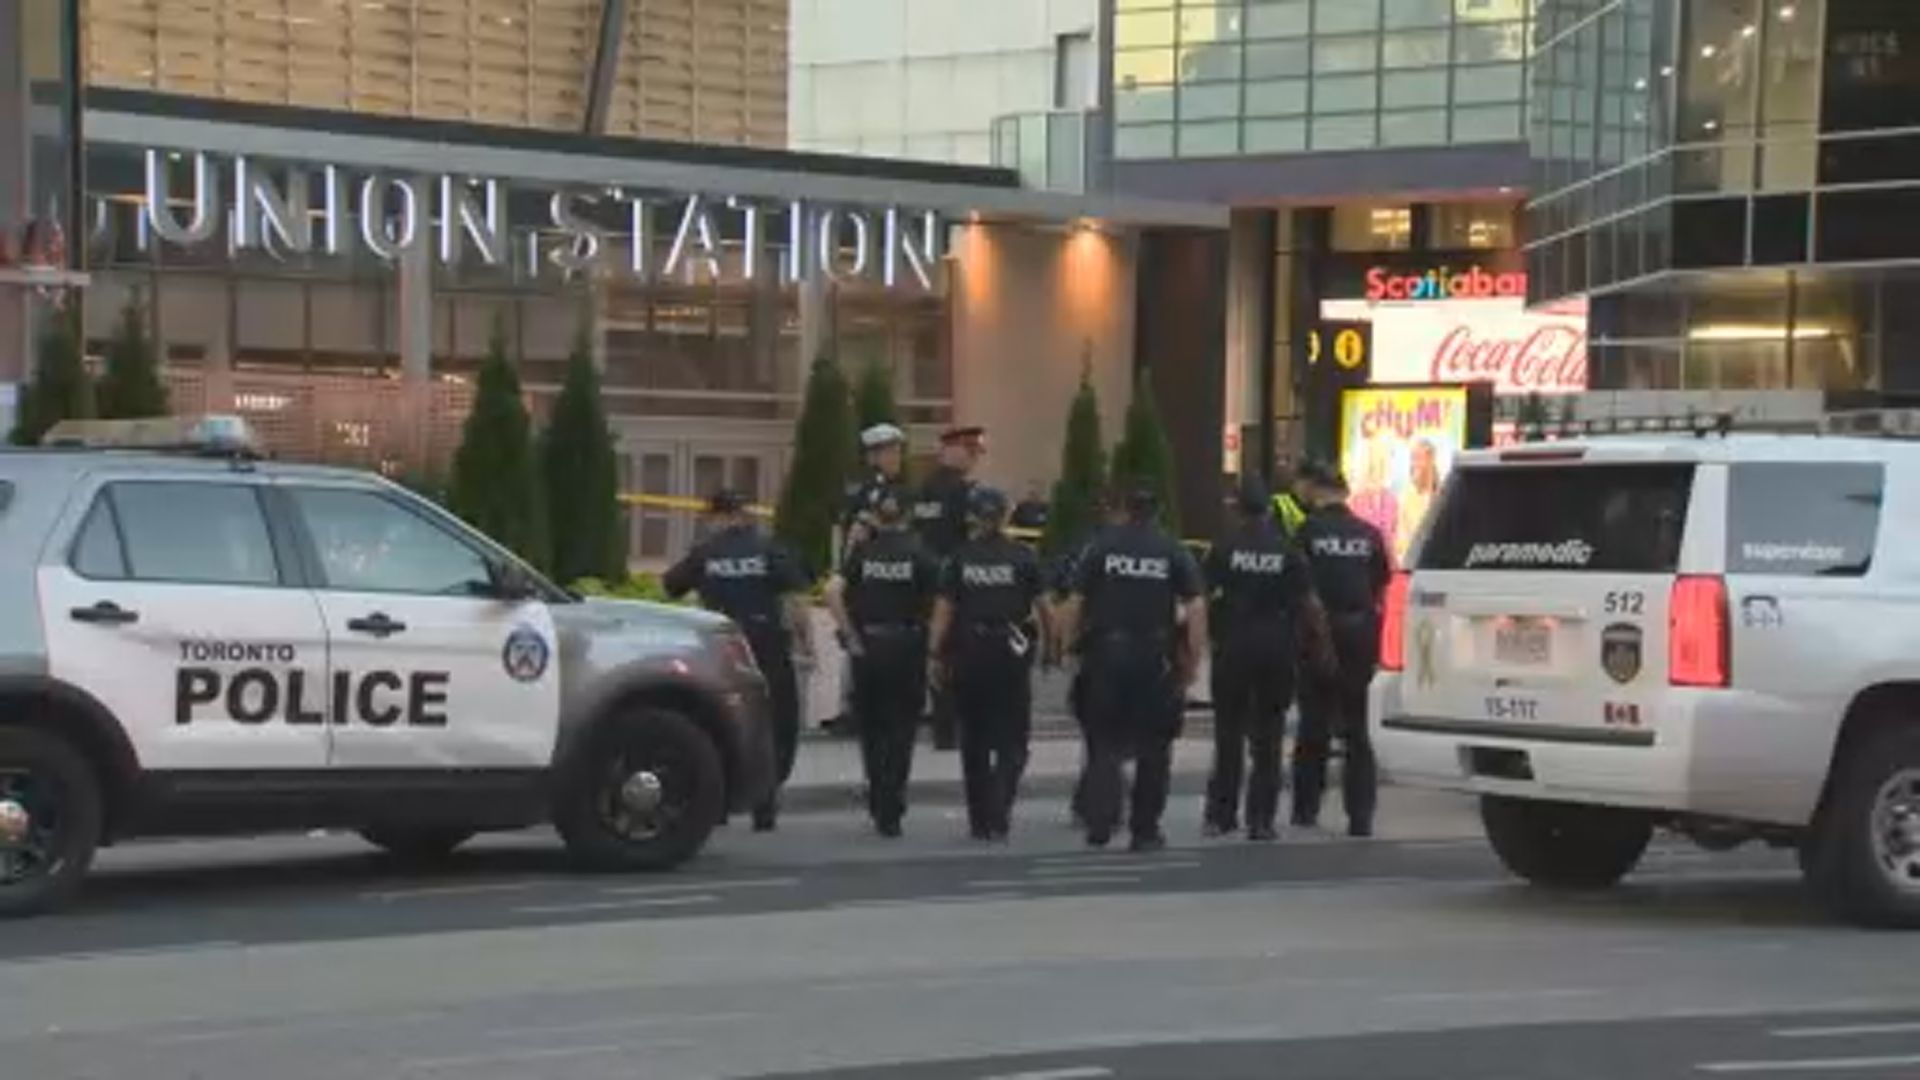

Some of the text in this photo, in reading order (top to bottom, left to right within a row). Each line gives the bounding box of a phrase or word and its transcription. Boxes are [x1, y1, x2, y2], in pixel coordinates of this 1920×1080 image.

[145, 149, 938, 290] UNION STATION
[1312, 537, 1371, 557] POLICE
[1464, 538, 1594, 569] paramedic
[705, 555, 767, 577] POLICE
[862, 560, 914, 581] POLICE
[1105, 553, 1169, 579] POLICE
[1231, 551, 1285, 573] POLICE
[962, 564, 1016, 585] POLICE
[1604, 591, 1645, 615] 512
[179, 641, 295, 662] TORONTO
[175, 667, 450, 727] POLICE
